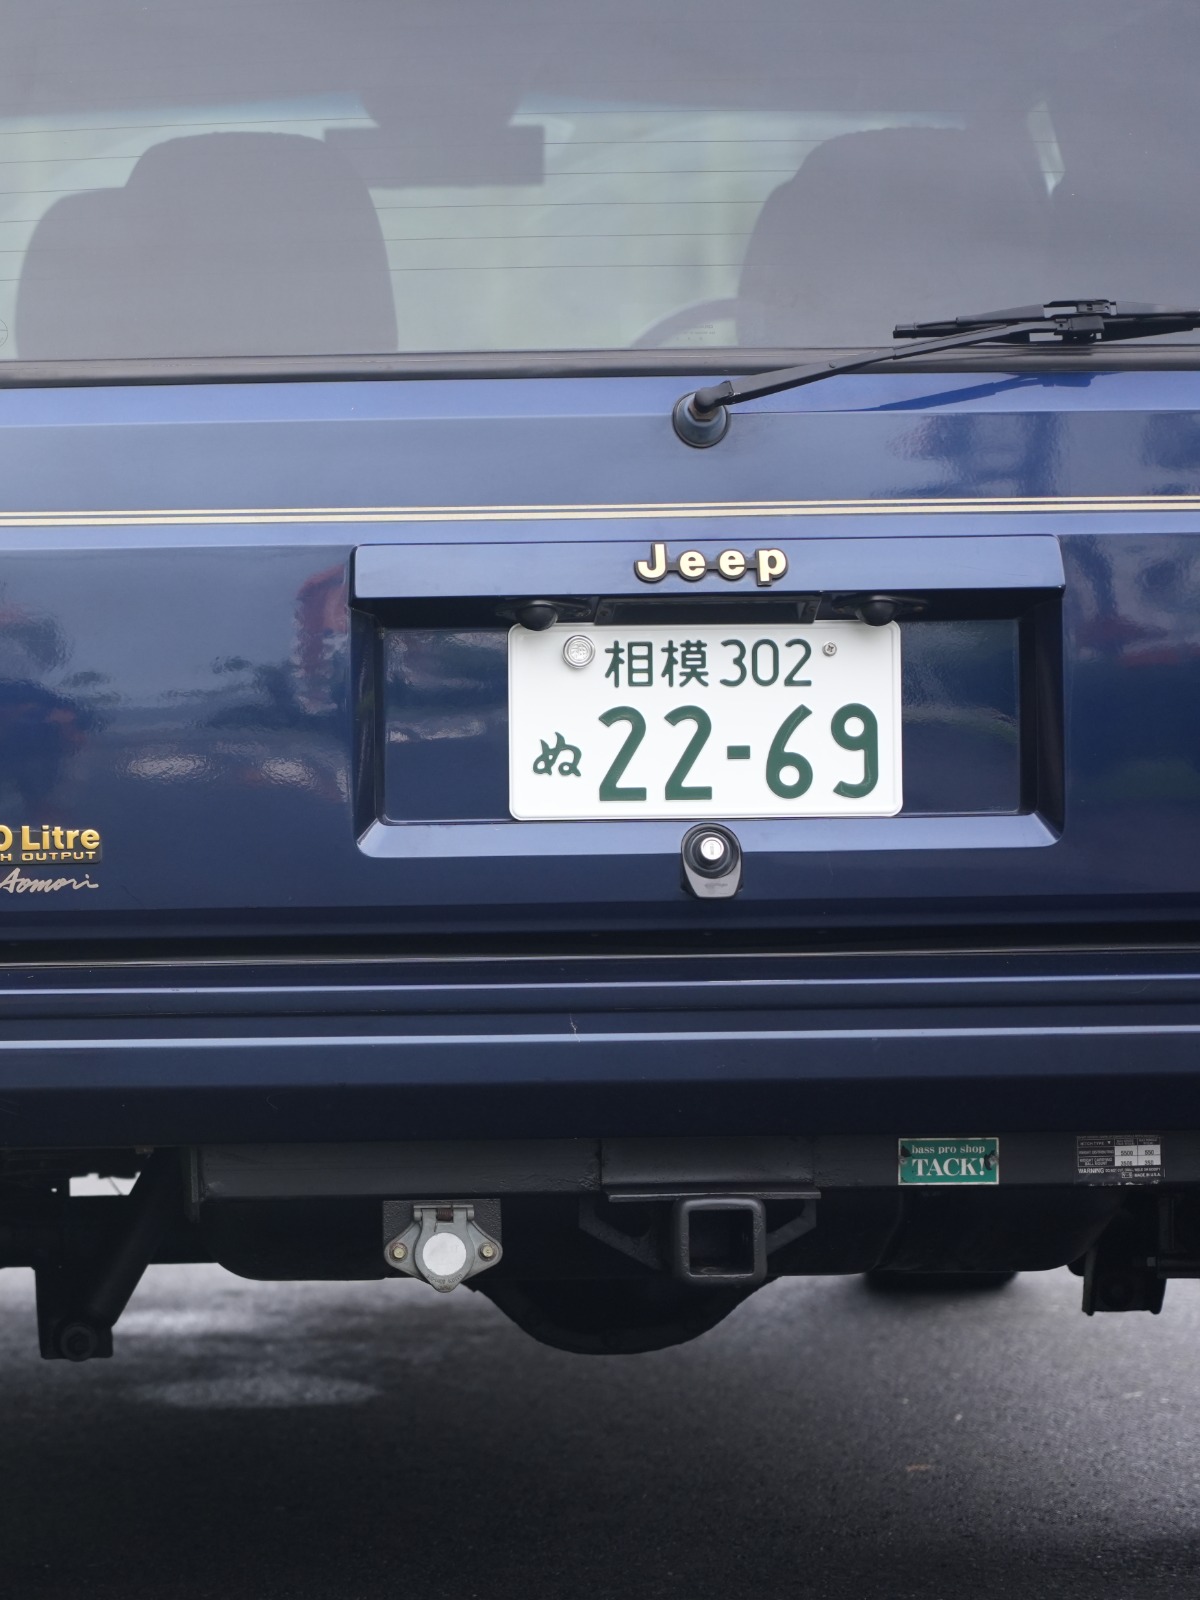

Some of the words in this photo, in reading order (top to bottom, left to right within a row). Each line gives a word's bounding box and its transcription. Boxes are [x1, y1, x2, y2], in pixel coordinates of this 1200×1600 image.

[634, 542, 788, 587] Jeep
[532, 731, 582, 777] ぬ
[598, 703, 880, 802] 22-69
[20, 824, 100, 851] Litre
[21, 851, 96, 861] OUTPUT
[911, 1145, 935, 1154] bass
[960, 1145, 986, 1154] shop
[911, 1157, 985, 1176] TACK!
